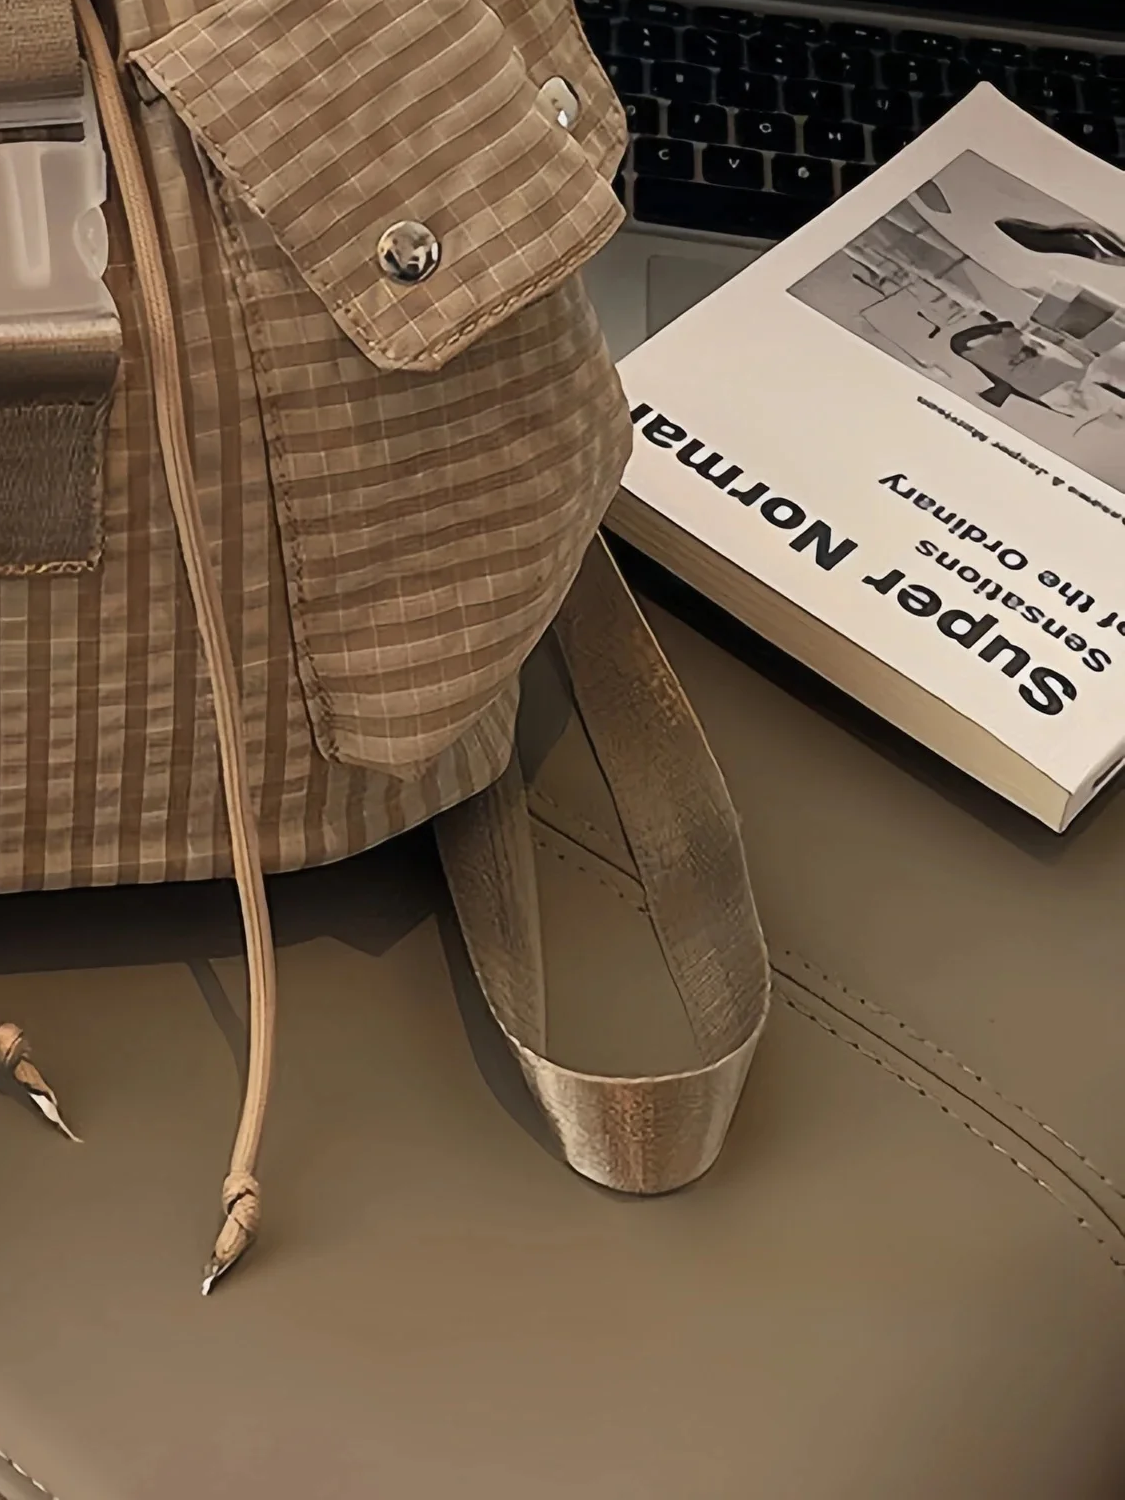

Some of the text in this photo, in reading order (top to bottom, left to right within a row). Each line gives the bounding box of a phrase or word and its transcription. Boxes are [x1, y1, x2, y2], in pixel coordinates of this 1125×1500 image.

[658, 149, 670, 160] C
[728, 158, 740, 169] V
[878, 473, 1028, 570] Ordinary
[914, 540, 1112, 672] Sensations
[1038, 570, 1095, 613] the
[862, 569, 1077, 715] Super
